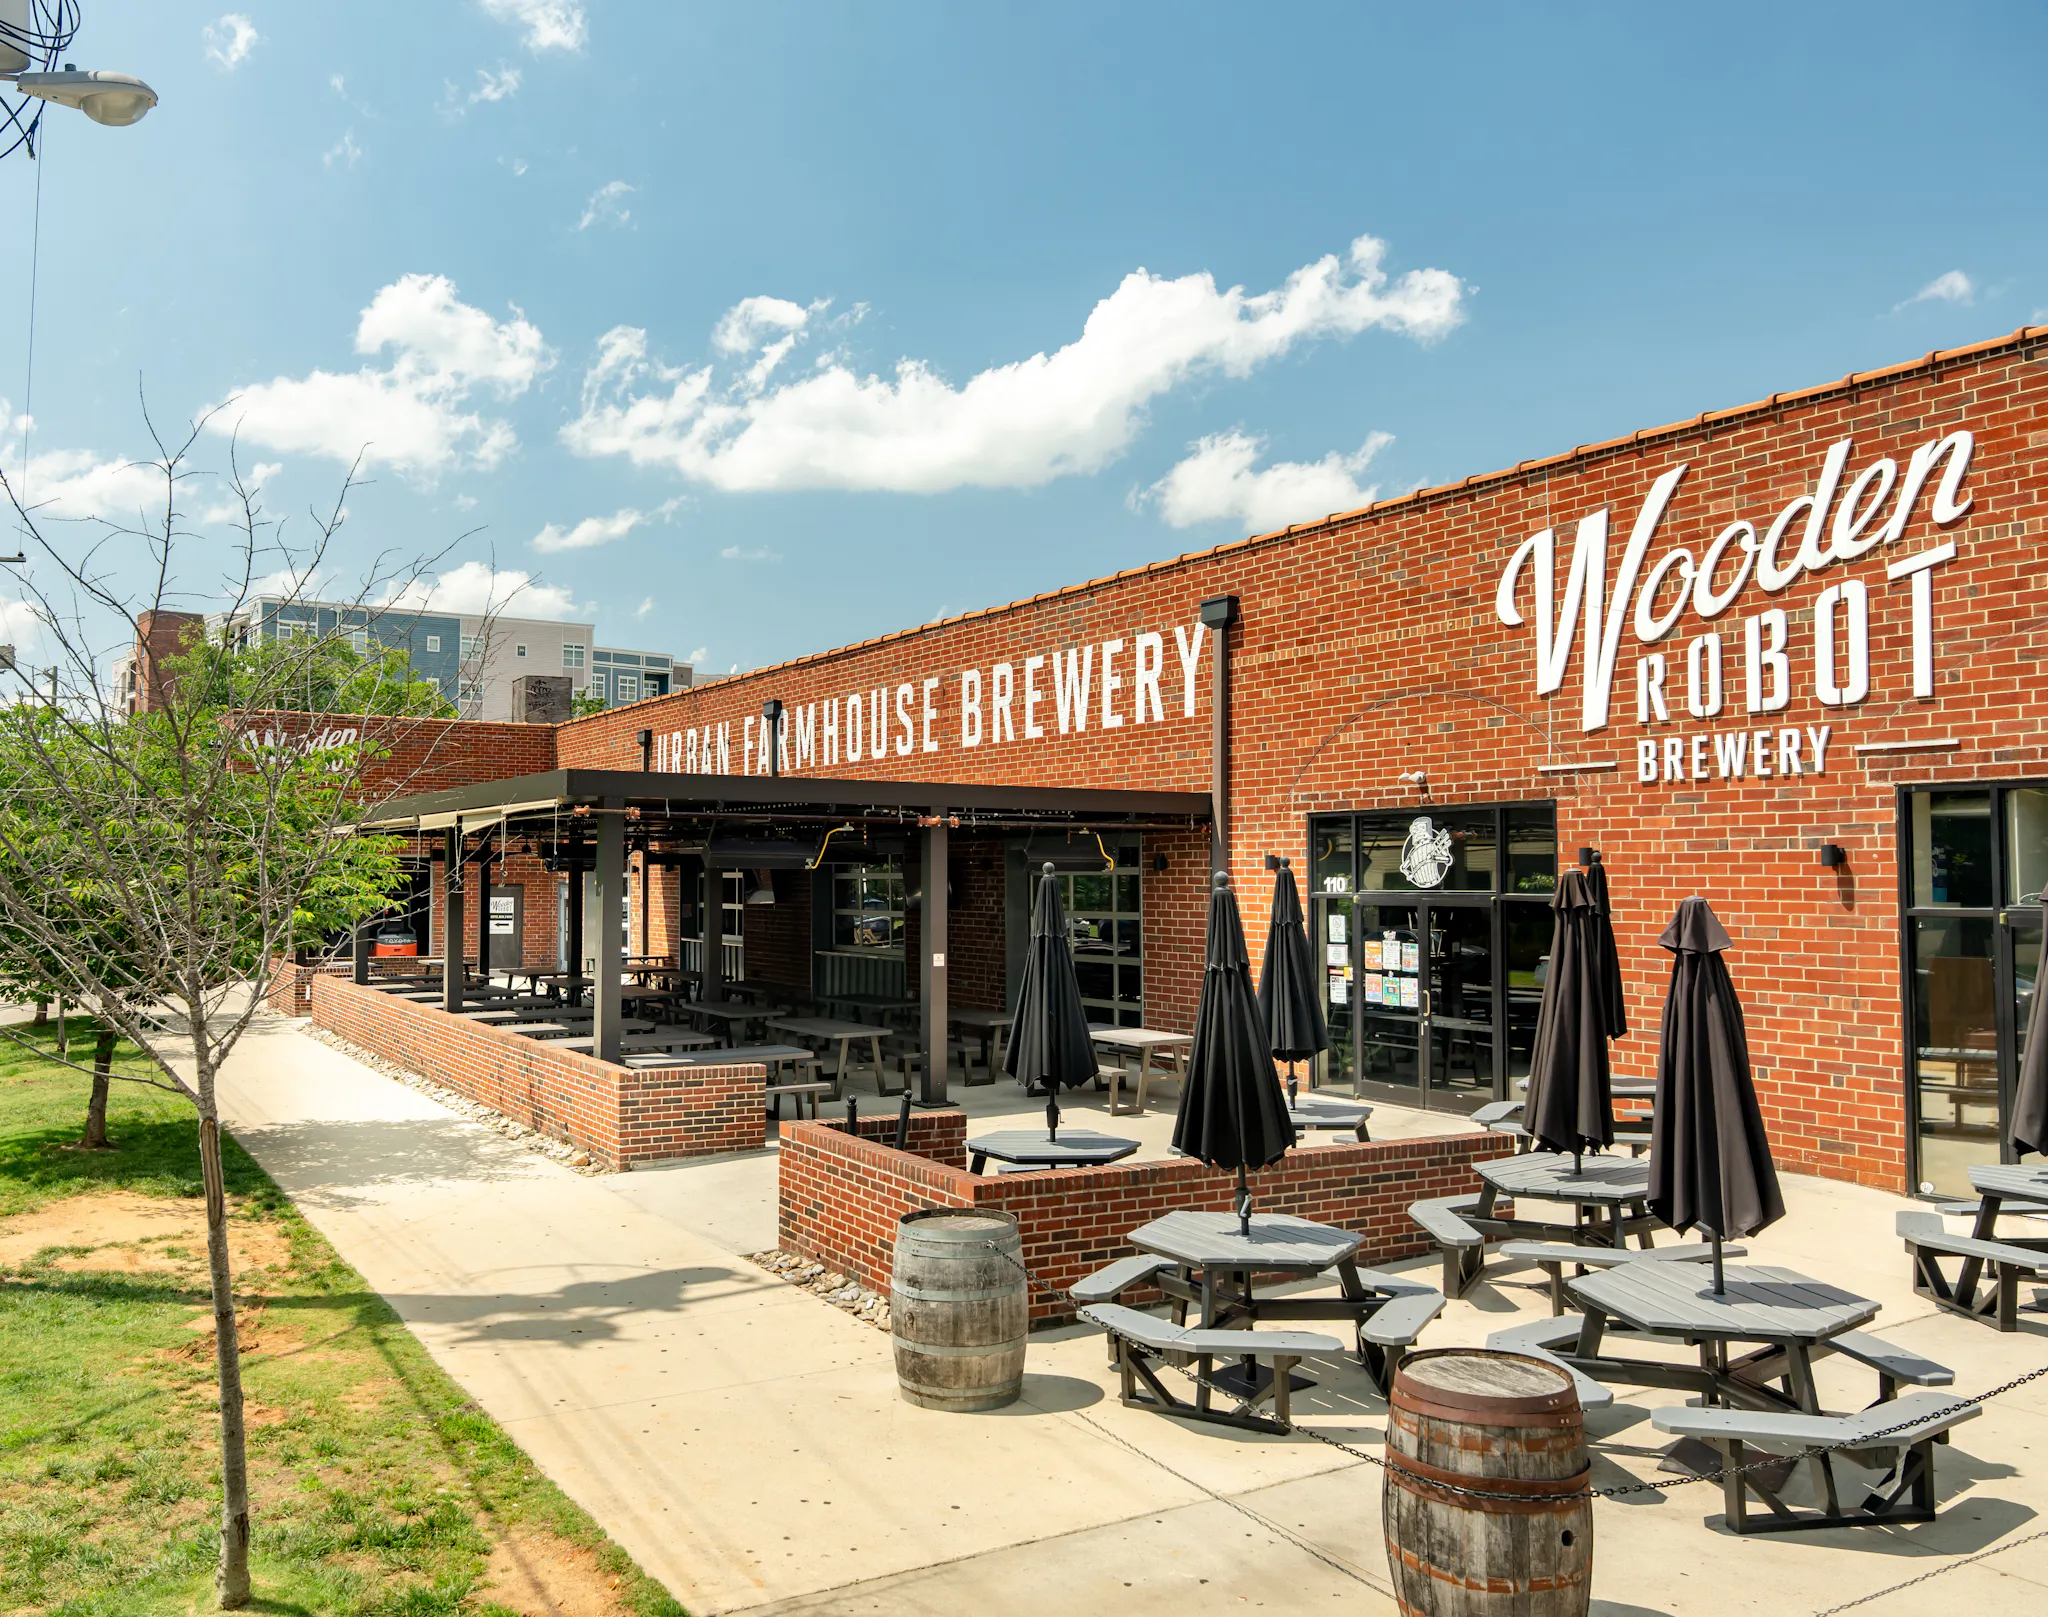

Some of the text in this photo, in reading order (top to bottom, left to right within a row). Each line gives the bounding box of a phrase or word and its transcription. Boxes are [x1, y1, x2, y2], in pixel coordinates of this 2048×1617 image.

[1496, 430, 1974, 733] Wooden
[1637, 542, 1957, 724] ROBOT
[657, 622, 1206, 777] URBAN FARMHOUSE BREWERY
[1638, 725, 1831, 782] BREWERY
[1324, 877, 1346, 892] 110
